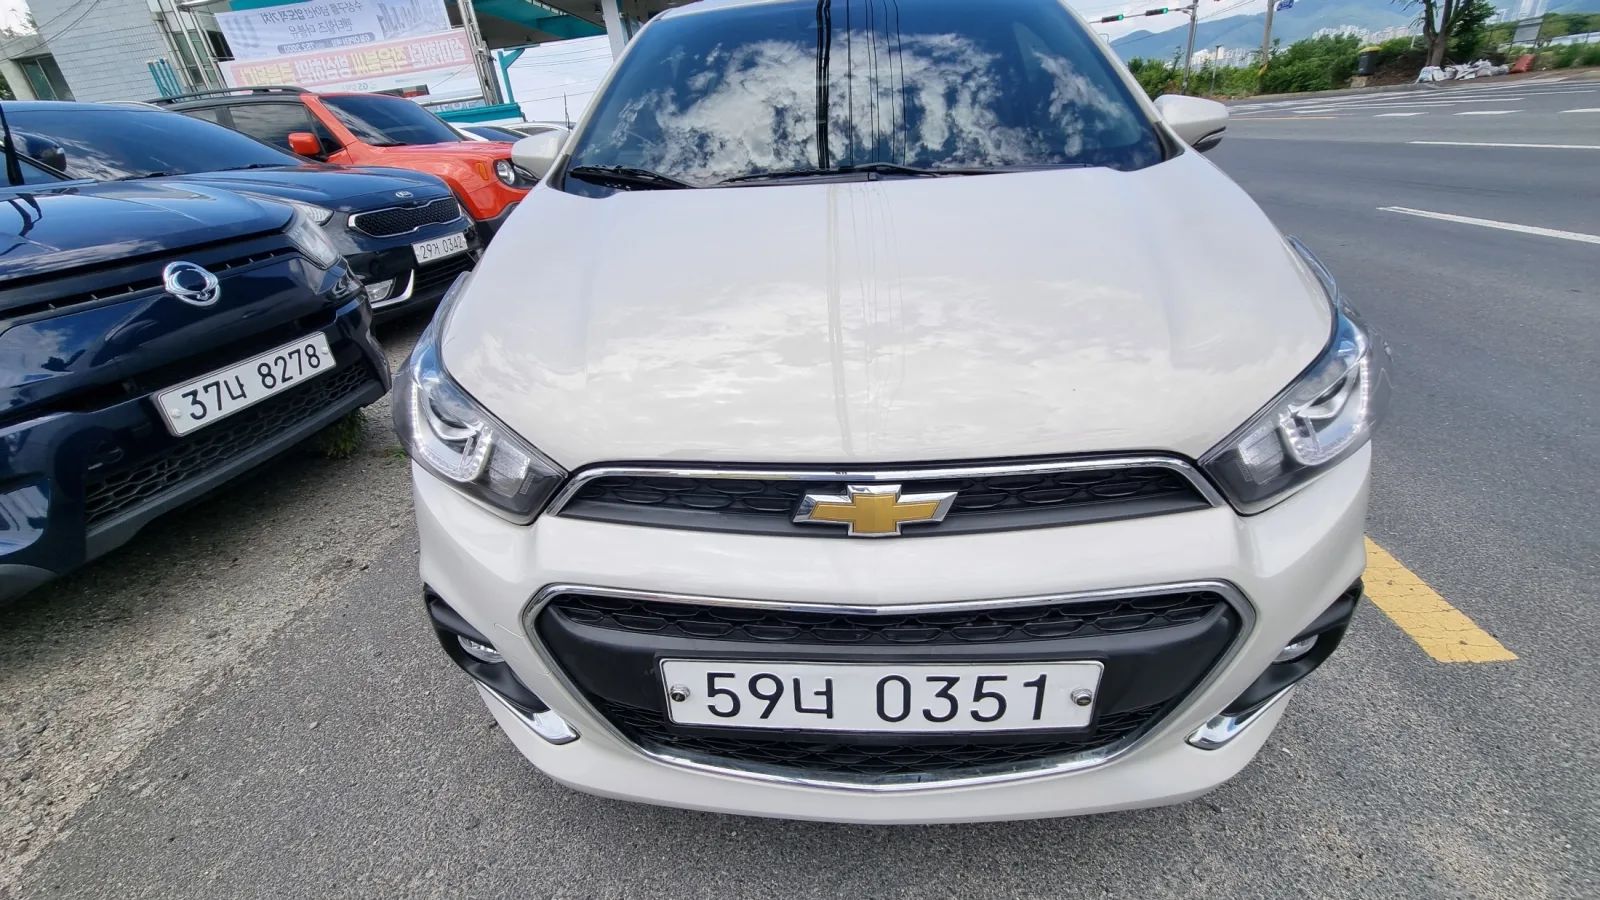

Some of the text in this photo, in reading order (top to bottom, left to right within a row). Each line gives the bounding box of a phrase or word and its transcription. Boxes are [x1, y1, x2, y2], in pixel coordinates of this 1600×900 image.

[442, 235, 464, 252] 0342
[181, 343, 321, 420] 37나 8278
[706, 672, 1049, 723] 59너 0351
